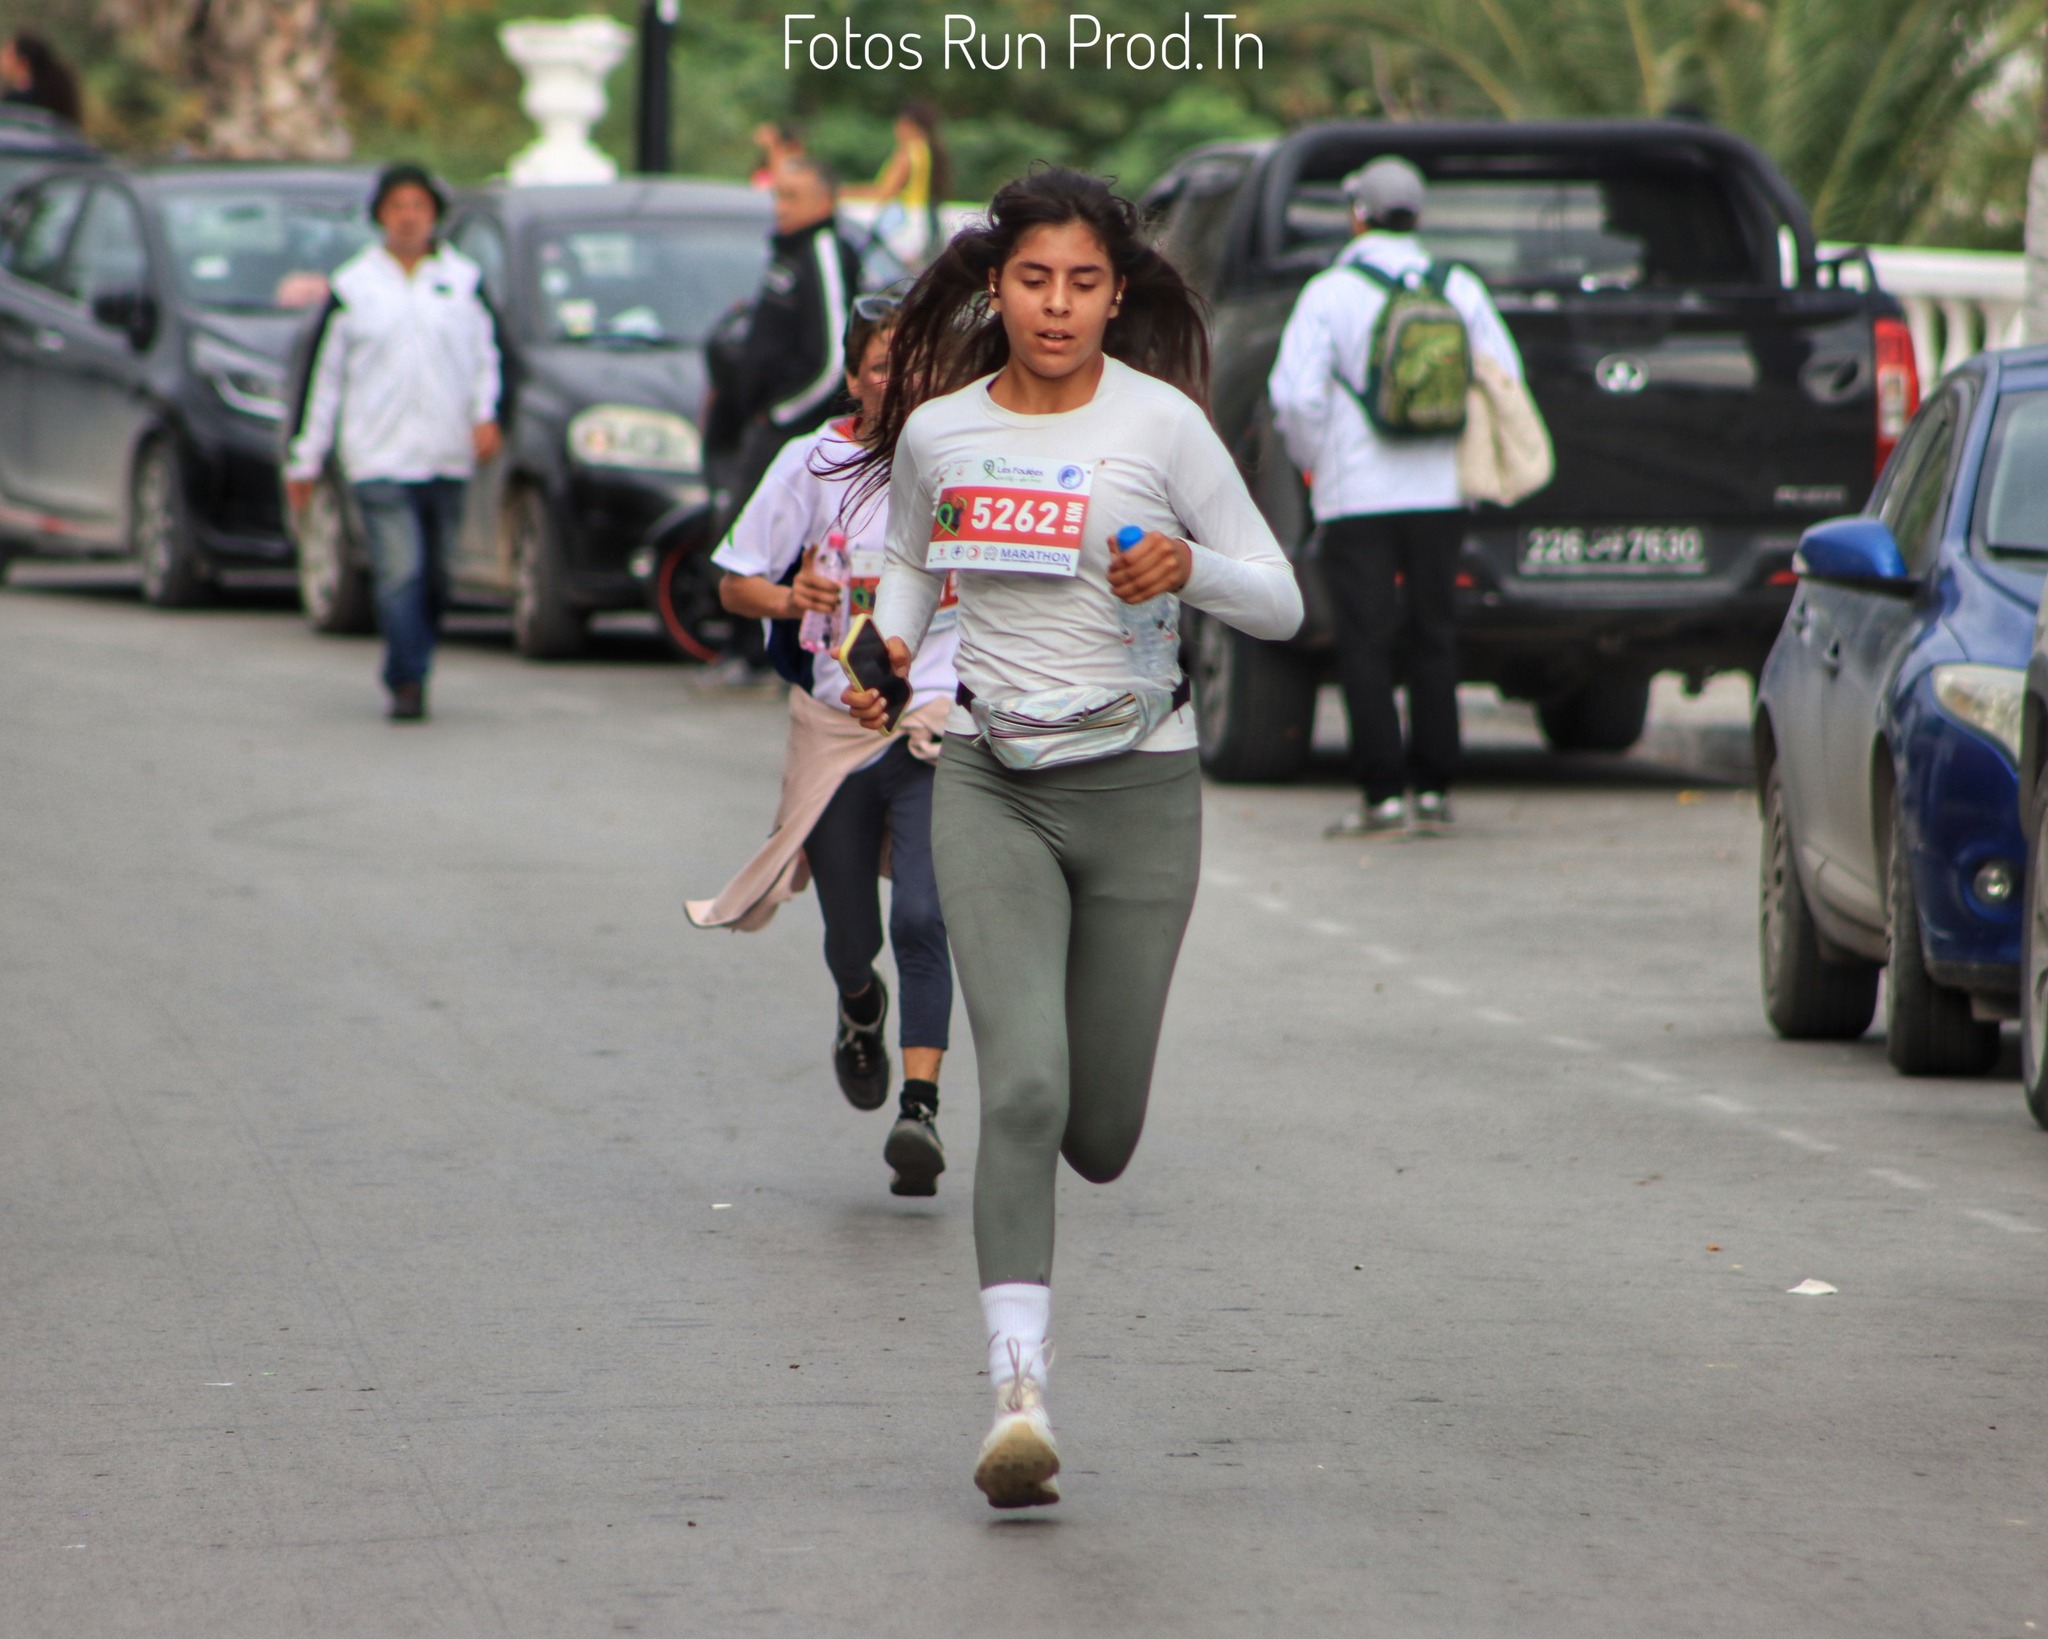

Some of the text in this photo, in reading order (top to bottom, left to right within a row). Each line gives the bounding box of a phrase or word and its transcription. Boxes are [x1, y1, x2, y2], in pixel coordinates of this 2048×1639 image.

[971, 497, 1059, 534] 5262
[1065, 502, 1084, 523] KM
[1001, 548, 1071, 563] MARATHON
[1528, 527, 1583, 561] 226
[1627, 527, 1702, 561] 7630
